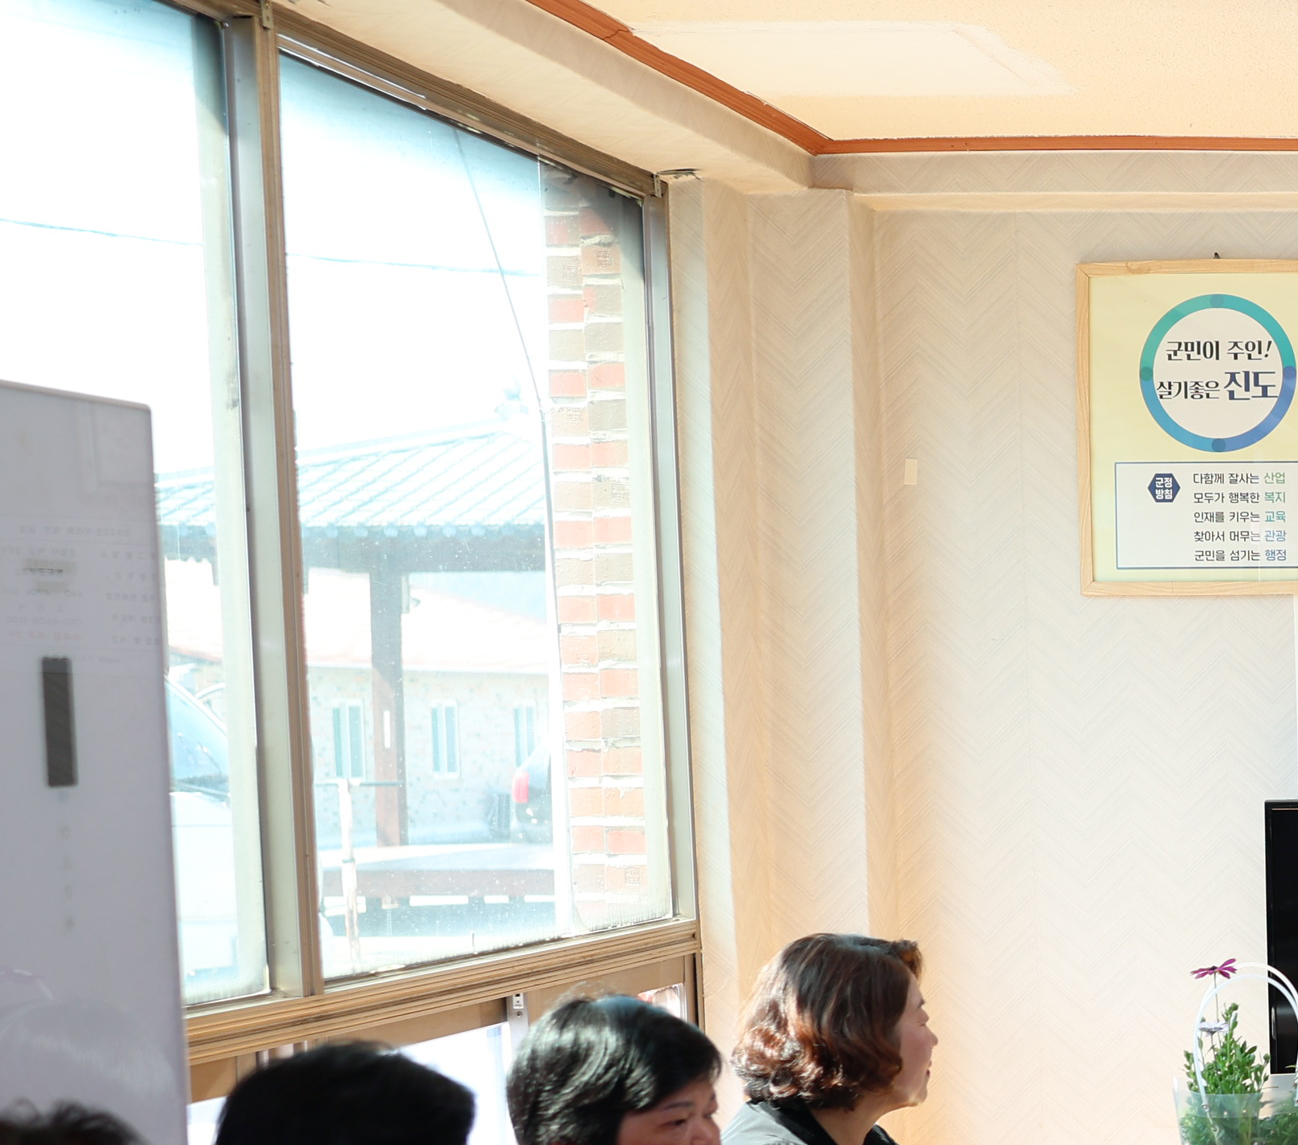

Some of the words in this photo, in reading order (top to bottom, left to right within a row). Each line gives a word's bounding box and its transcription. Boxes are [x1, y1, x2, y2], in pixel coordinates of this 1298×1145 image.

[1166, 340, 1220, 361] 군민이
[1226, 340, 1273, 361] 주인!
[1156, 381, 1220, 400] 살기좋은
[1224, 371, 1279, 401] 진도
[1155, 477, 1173, 489] 군정
[1193, 473, 1225, 485] 다함께
[1228, 473, 1260, 485] 잘사는
[1263, 472, 1286, 485] 산업
[1155, 489, 1173, 500] 방침
[1193, 492, 1225, 504] 모두가
[1228, 492, 1260, 504] 행복한
[1264, 491, 1286, 504] 복지
[1193, 512, 1225, 523] 인재를
[1229, 512, 1260, 523] 키우는
[1264, 511, 1287, 523] 교육
[1193, 531, 1226, 543] 찾아서
[1229, 531, 1260, 543] 머무는
[1264, 530, 1287, 543] 관광
[1194, 550, 1226, 562] 군민을
[1229, 550, 1261, 562] 섬기는
[1265, 549, 1287, 562] 행정
